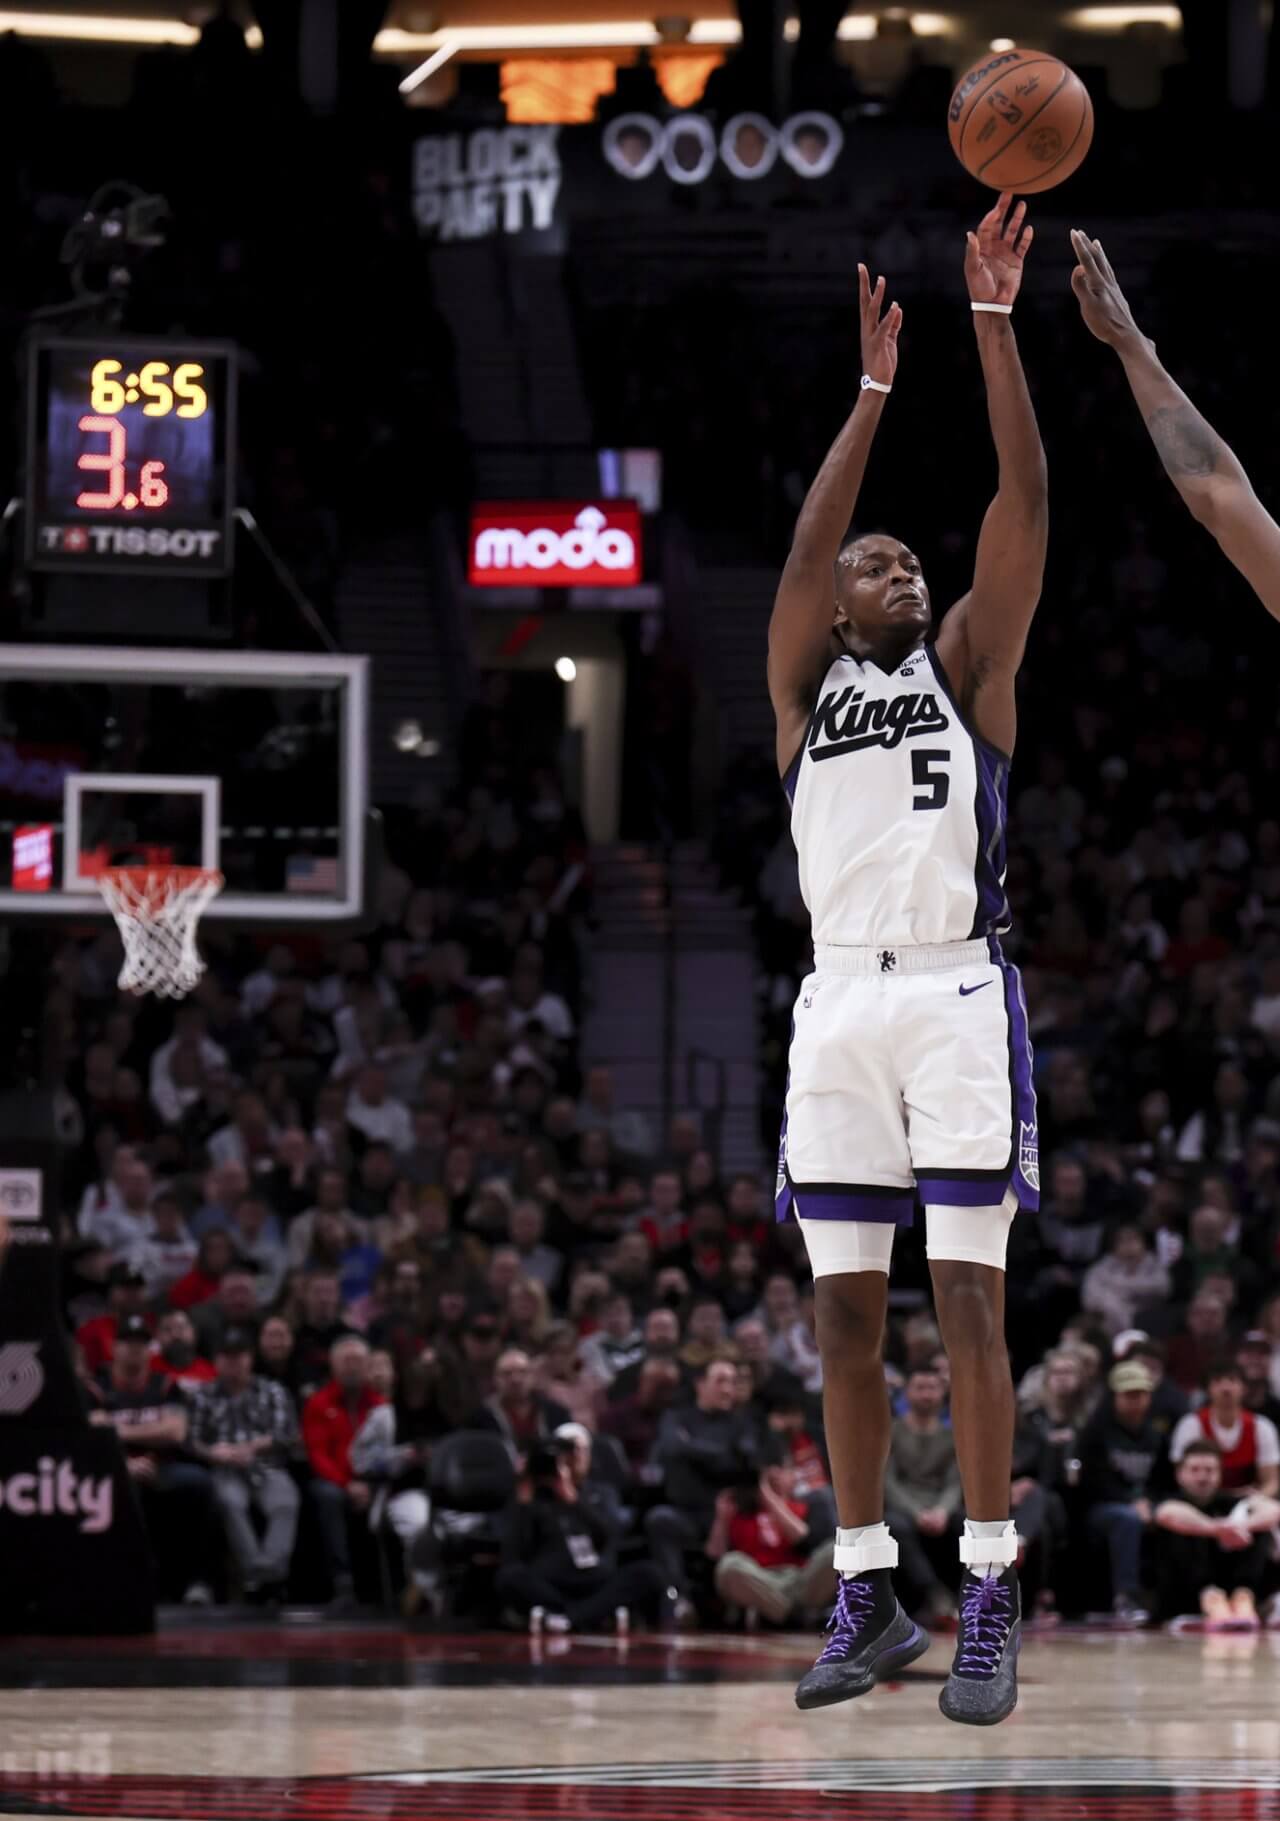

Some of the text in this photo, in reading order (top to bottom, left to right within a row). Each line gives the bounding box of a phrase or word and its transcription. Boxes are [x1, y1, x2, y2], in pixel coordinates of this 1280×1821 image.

[415, 126, 560, 189] BLOCK
[91, 359, 208, 419] 6:55
[76, 416, 168, 510] 3.6
[88, 527, 220, 558] TISSOT
[475, 505, 635, 570] moda
[807, 685, 949, 762] Kings
[911, 749, 951, 811] 5
[0, 1455, 114, 1534] city
